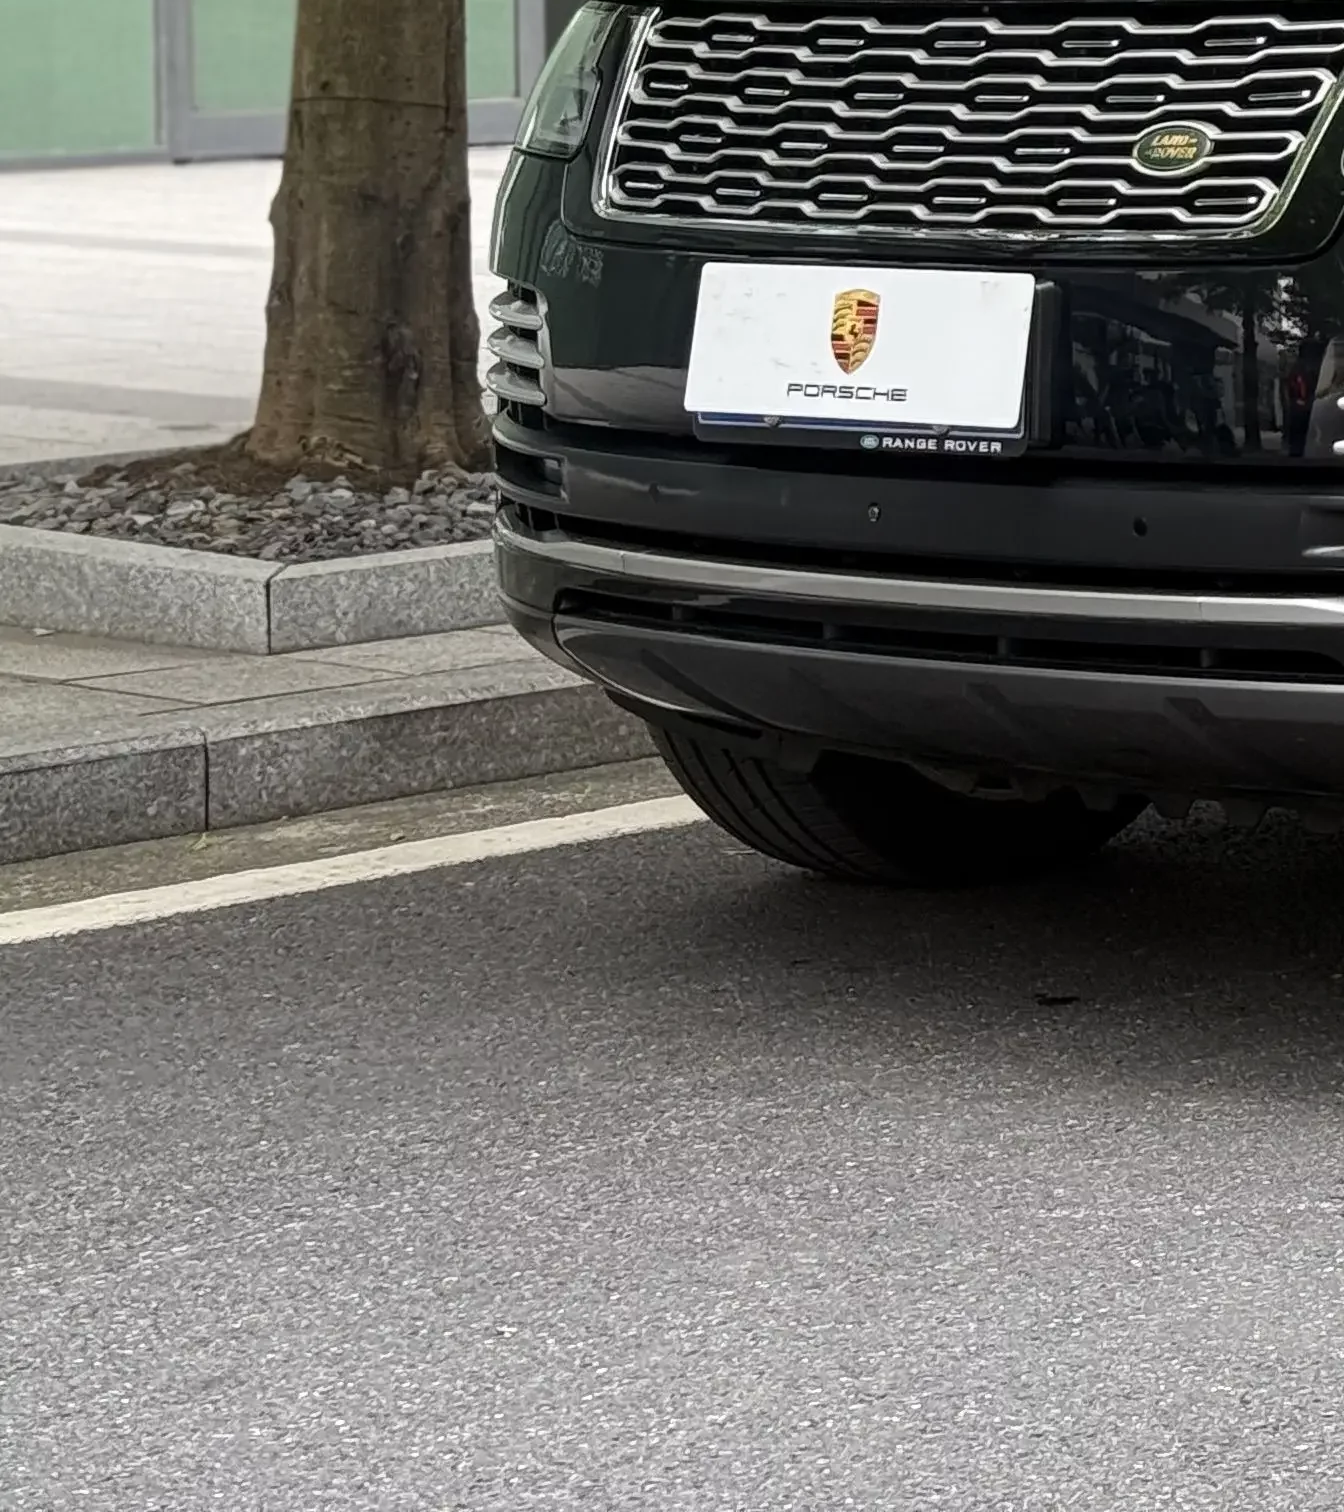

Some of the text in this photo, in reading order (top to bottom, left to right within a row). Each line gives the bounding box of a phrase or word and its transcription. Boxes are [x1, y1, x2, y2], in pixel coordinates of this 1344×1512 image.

[787, 383, 909, 402] PORSCHE
[882, 437, 938, 451] RANGE
[943, 439, 1003, 454] ROVER
